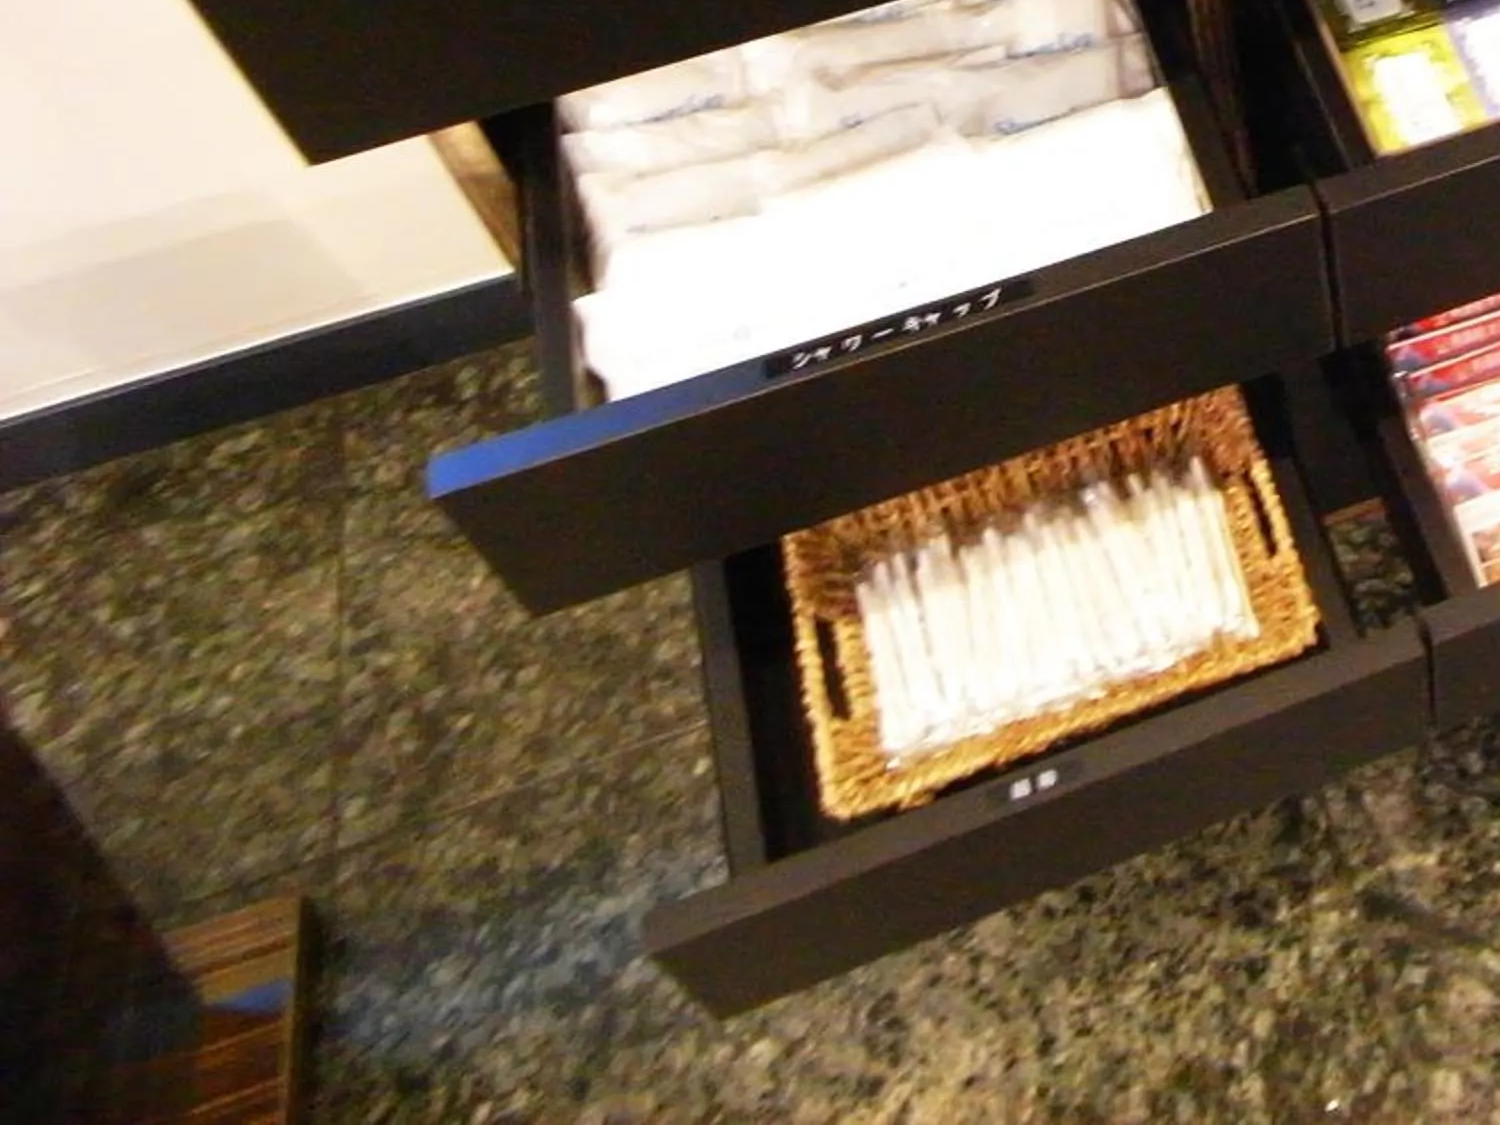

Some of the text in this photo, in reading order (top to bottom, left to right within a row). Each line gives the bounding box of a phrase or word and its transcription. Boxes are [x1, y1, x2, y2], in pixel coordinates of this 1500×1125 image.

[792, 286, 1002, 371] シャワーキャップ
